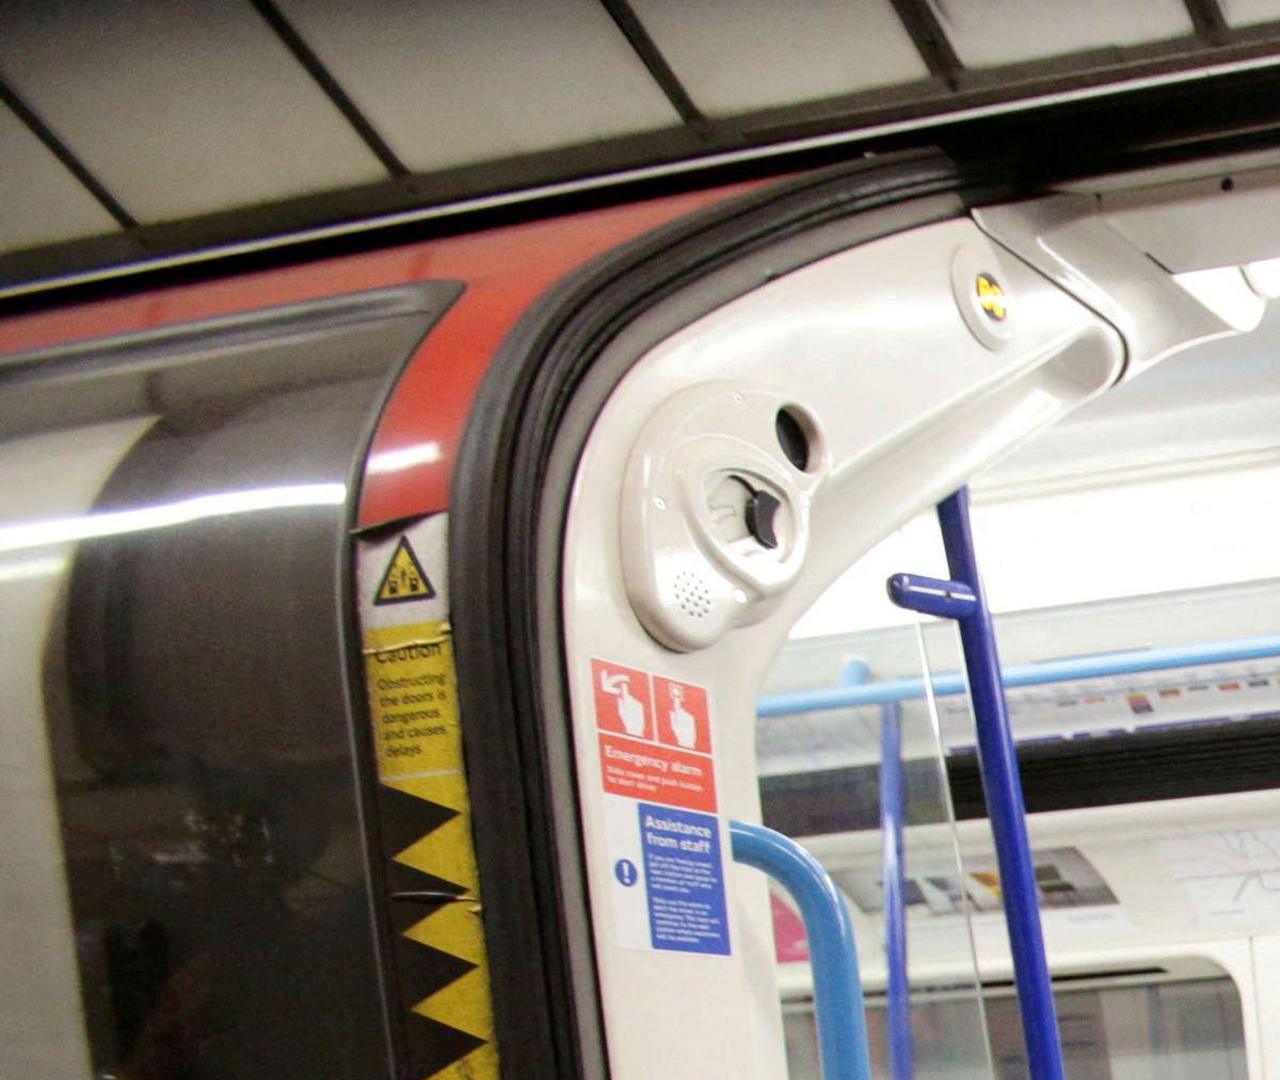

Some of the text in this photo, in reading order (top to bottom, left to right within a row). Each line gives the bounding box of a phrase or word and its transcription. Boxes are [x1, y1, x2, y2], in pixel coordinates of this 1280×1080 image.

[375, 643, 441, 663] Caution
[378, 674, 446, 689] Obstructing
[379, 689, 447, 708] the doors is
[382, 709, 440, 724] dangerous
[383, 726, 446, 741] and causes
[387, 745, 422, 757] delays
[604, 744, 669, 773] Emergency
[671, 761, 704, 777] alarm
[645, 814, 713, 839] Assistance
[646, 831, 711, 854] from staff
